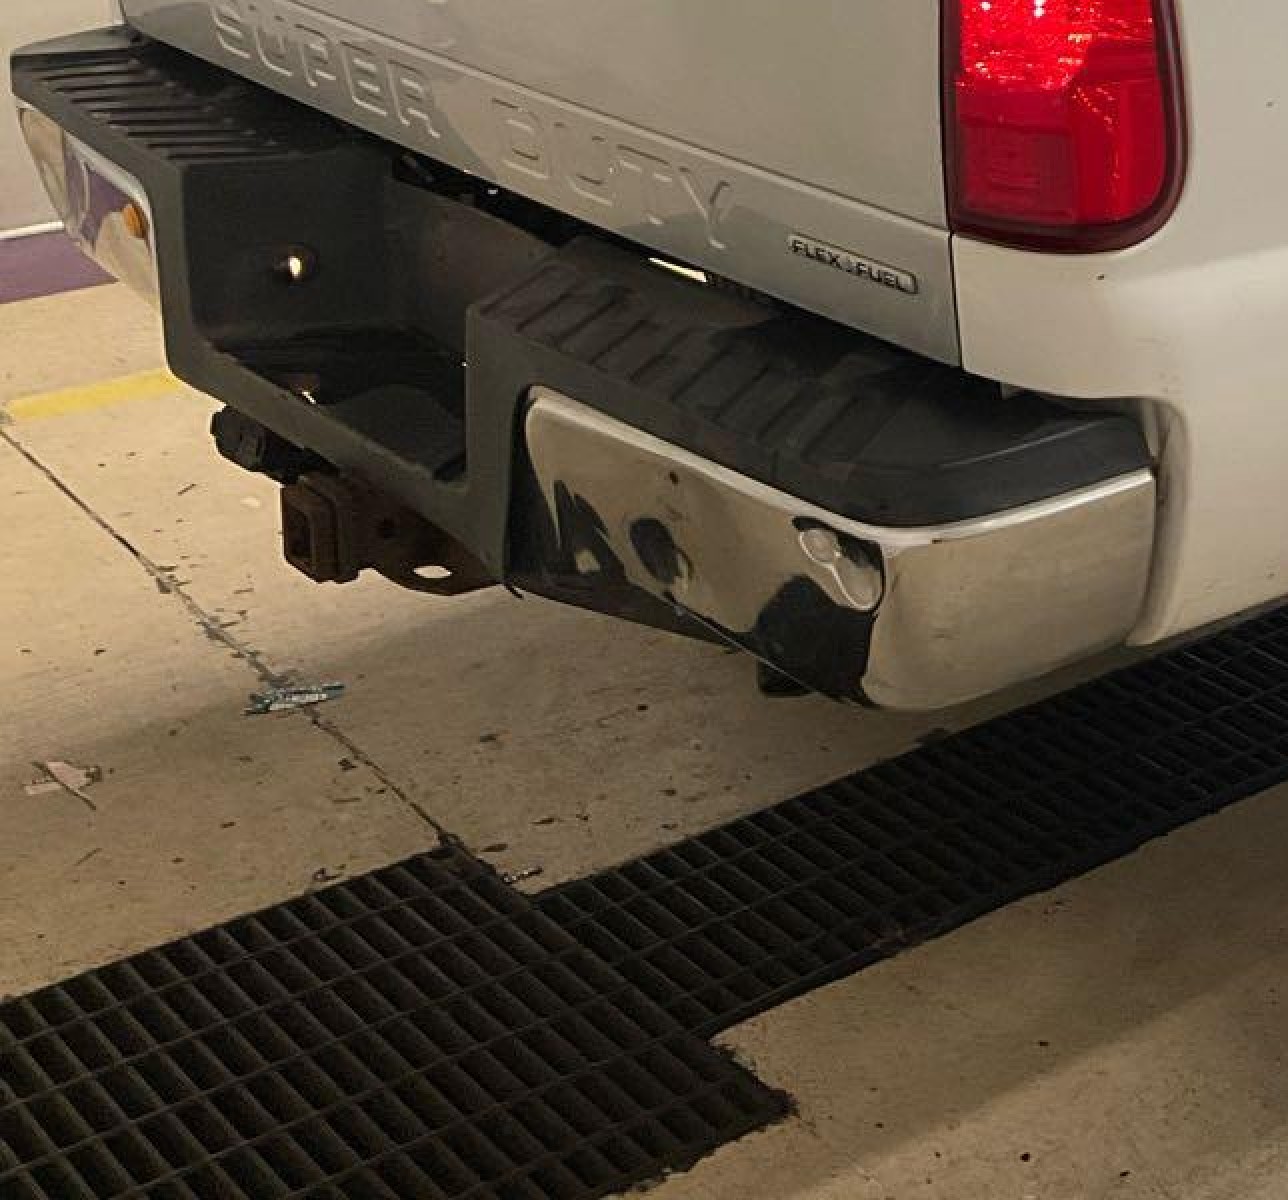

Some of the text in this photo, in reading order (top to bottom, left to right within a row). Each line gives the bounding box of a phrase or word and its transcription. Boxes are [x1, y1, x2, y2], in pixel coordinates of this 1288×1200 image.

[491, 97, 730, 250] DUTY
[791, 239, 906, 291] FLEX FUEL
